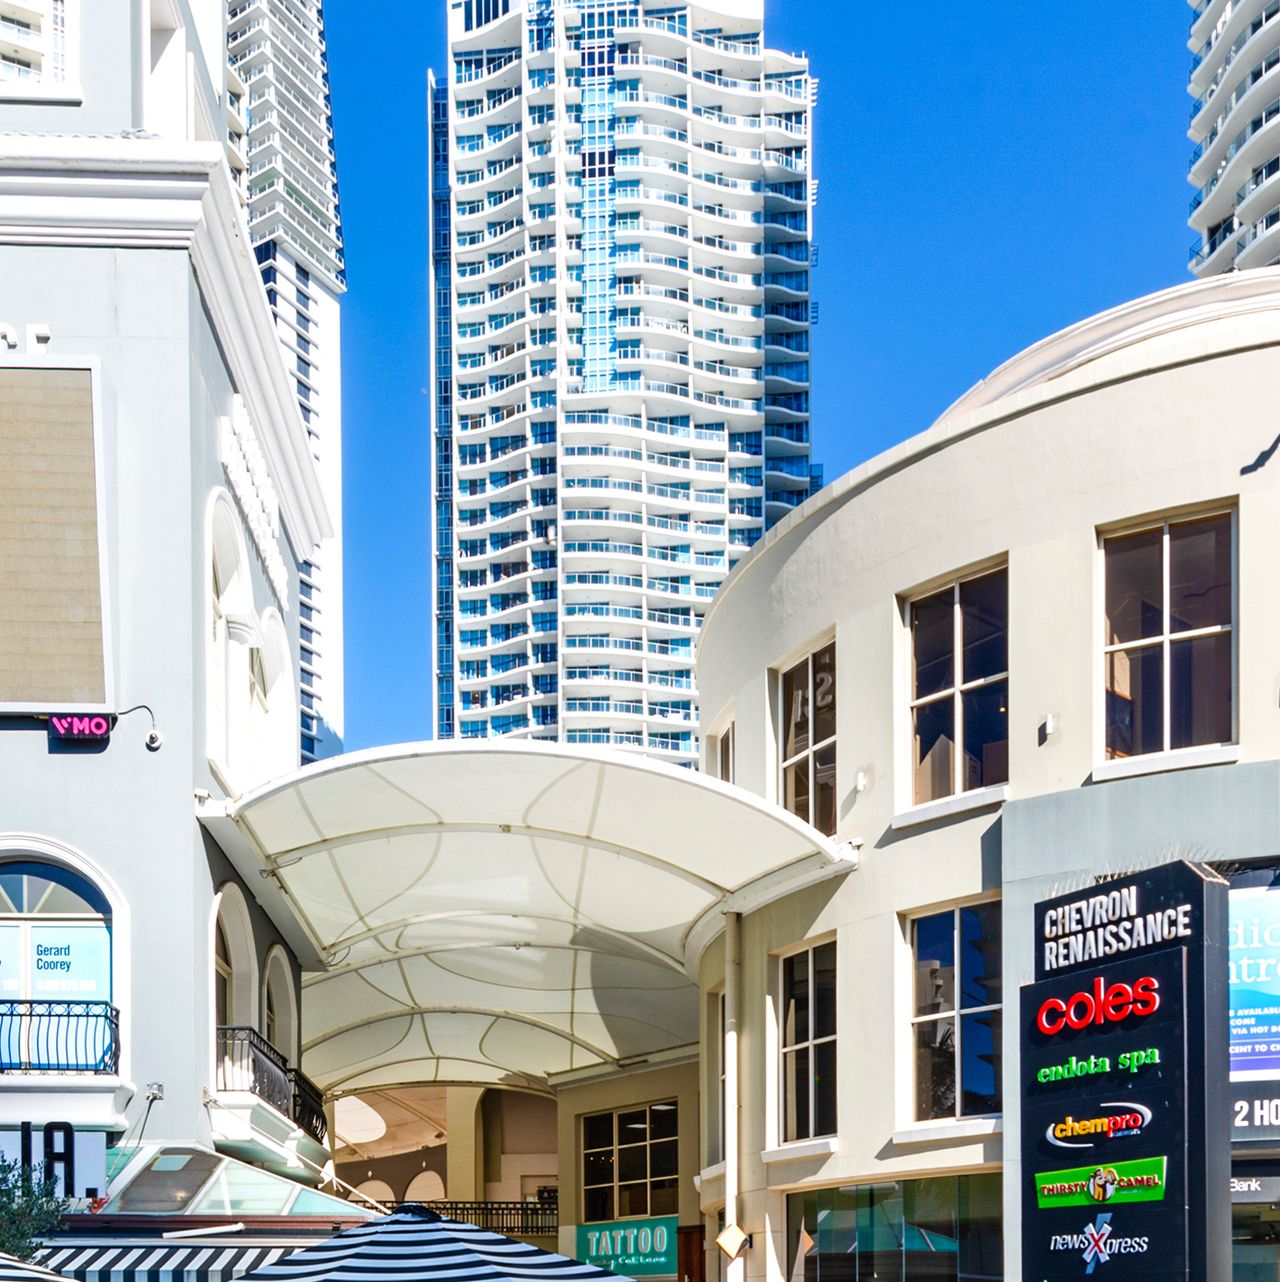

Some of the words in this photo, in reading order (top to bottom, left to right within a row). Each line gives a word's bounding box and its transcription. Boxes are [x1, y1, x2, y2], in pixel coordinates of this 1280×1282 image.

[1045, 886, 1137, 939] CHEVRON
[1044, 904, 1192, 971] RENAISSANCE
[36, 944, 71, 957] Gerard
[36, 958, 72, 972] Coorey
[1037, 976, 1161, 1036] coles
[1230, 1017, 1256, 1026] COME
[1232, 1027, 1248, 1035] VIA
[1250, 1025, 1270, 1034] HOT
[1254, 1043, 1268, 1052] TO
[1037, 1055, 1111, 1084] endota
[1118, 1048, 1161, 1073] spa
[1054, 1112, 1143, 1138] chempro
[1234, 1100, 1250, 1127] 2
[1040, 1181, 1088, 1197] THIRSTY
[1117, 1174, 1161, 1189] CAMEL
[1230, 1178, 1262, 1192] Bank
[587, 1226, 667, 1257] TATTOO
[618, 1255, 639, 1265] Cat
[639, 1254, 668, 1264] Lane
